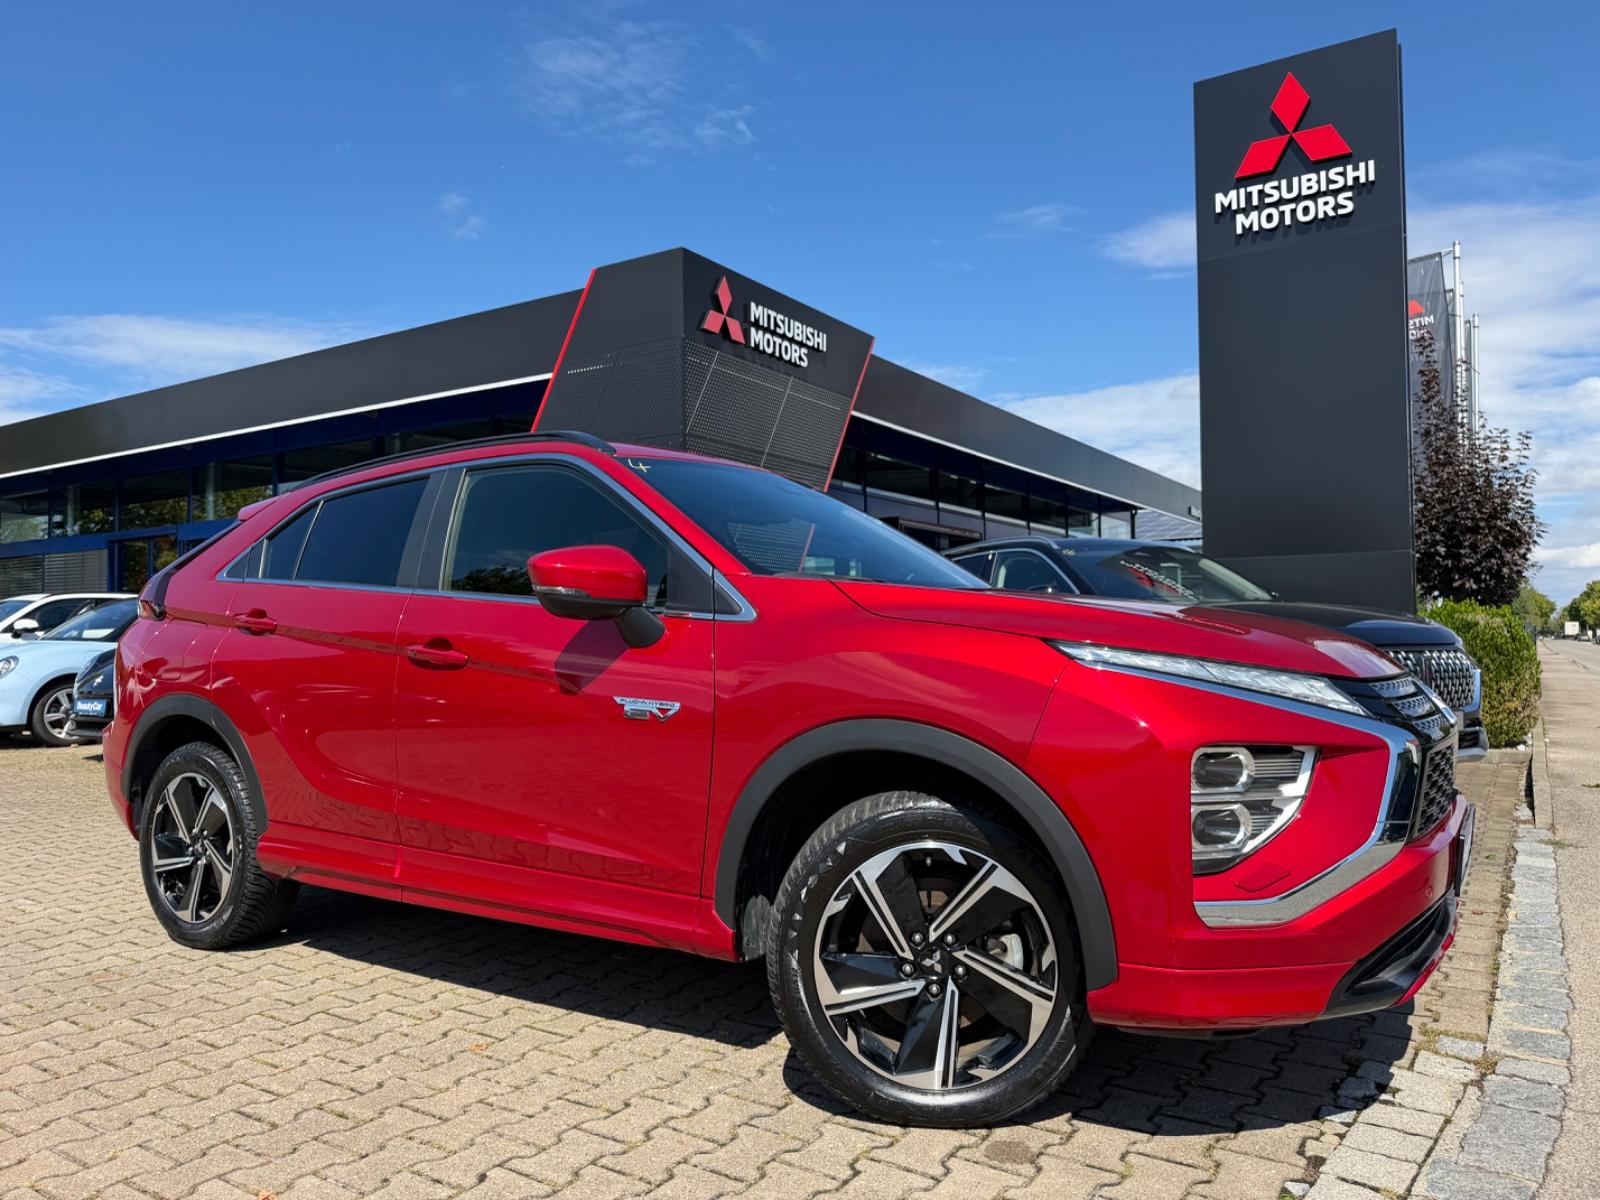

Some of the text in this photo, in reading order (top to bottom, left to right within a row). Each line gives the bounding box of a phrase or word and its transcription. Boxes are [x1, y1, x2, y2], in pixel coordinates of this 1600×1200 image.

[1214, 159, 1376, 214] MITSUBISHI
[1235, 191, 1355, 235] MOTORS
[750, 301, 827, 352] MITSUBISHI
[750, 327, 809, 368] MOTORS
